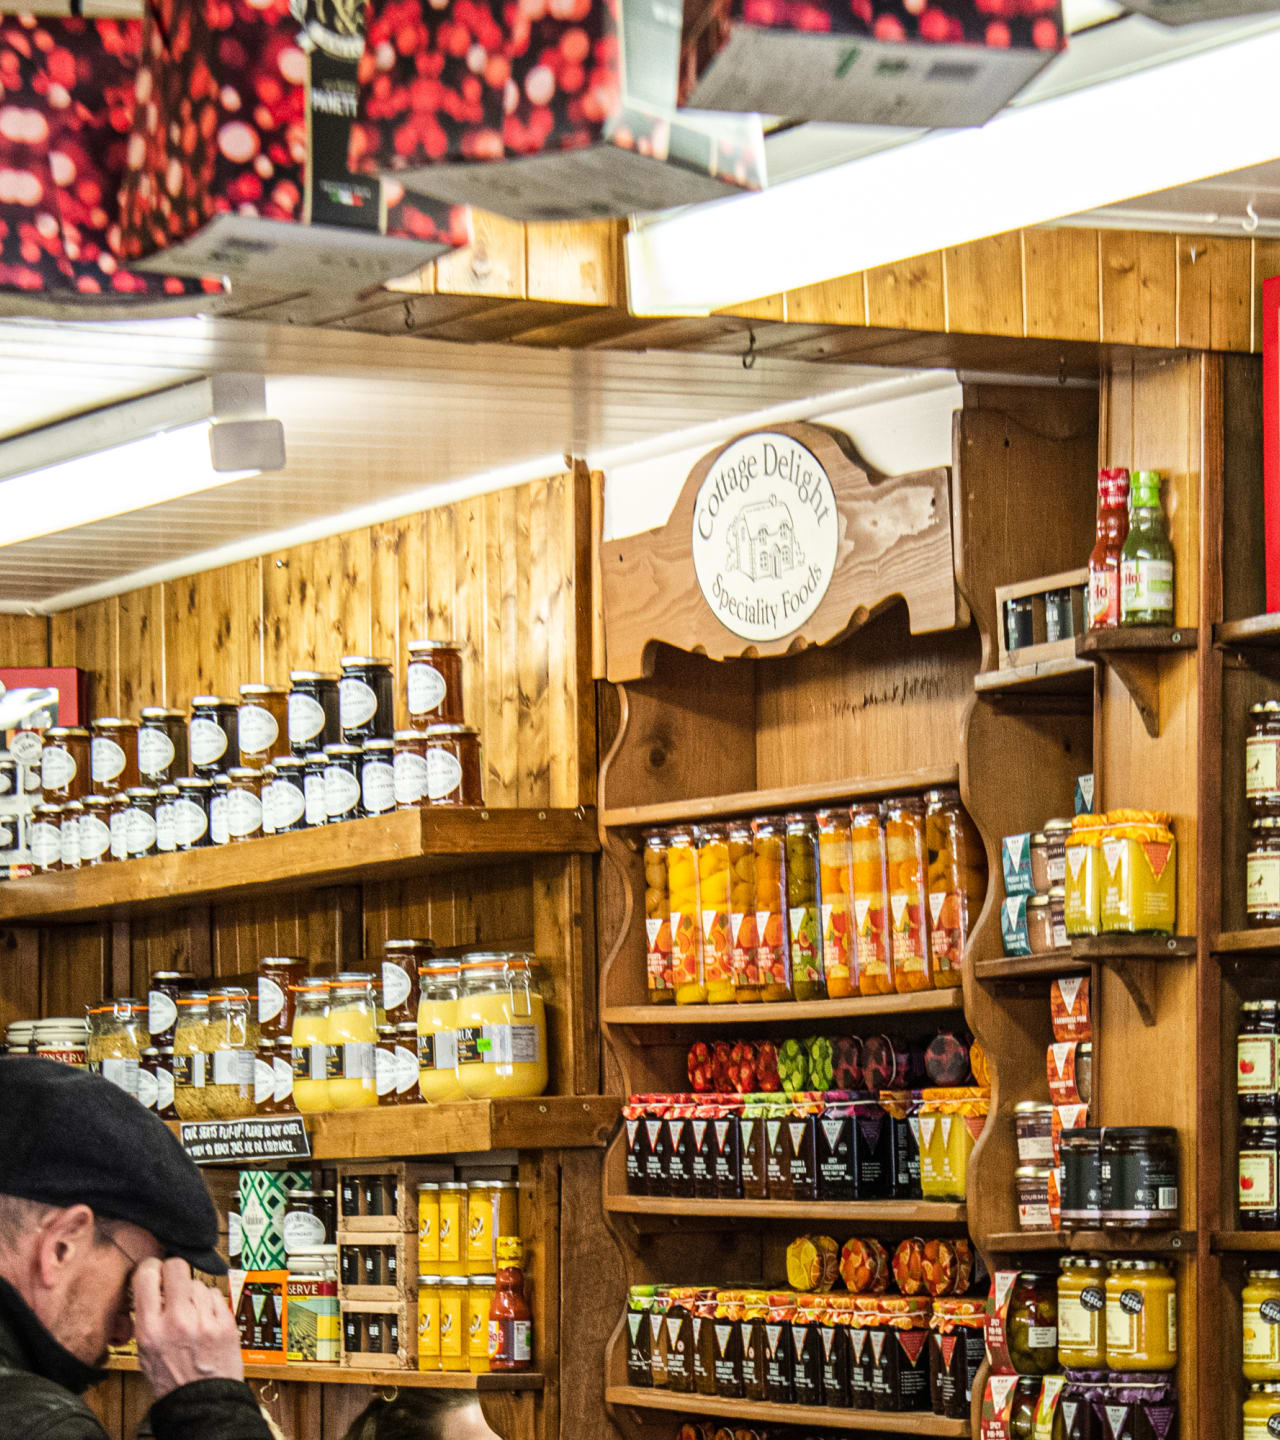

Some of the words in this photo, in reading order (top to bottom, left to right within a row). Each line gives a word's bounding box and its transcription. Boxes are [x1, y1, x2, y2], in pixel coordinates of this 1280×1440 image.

[698, 454, 758, 540] Cottage
[763, 443, 830, 527] Delight
[712, 573, 778, 630] Speciality
[781, 565, 822, 619] Foods
[39, 1051, 84, 1063] CONSERV
